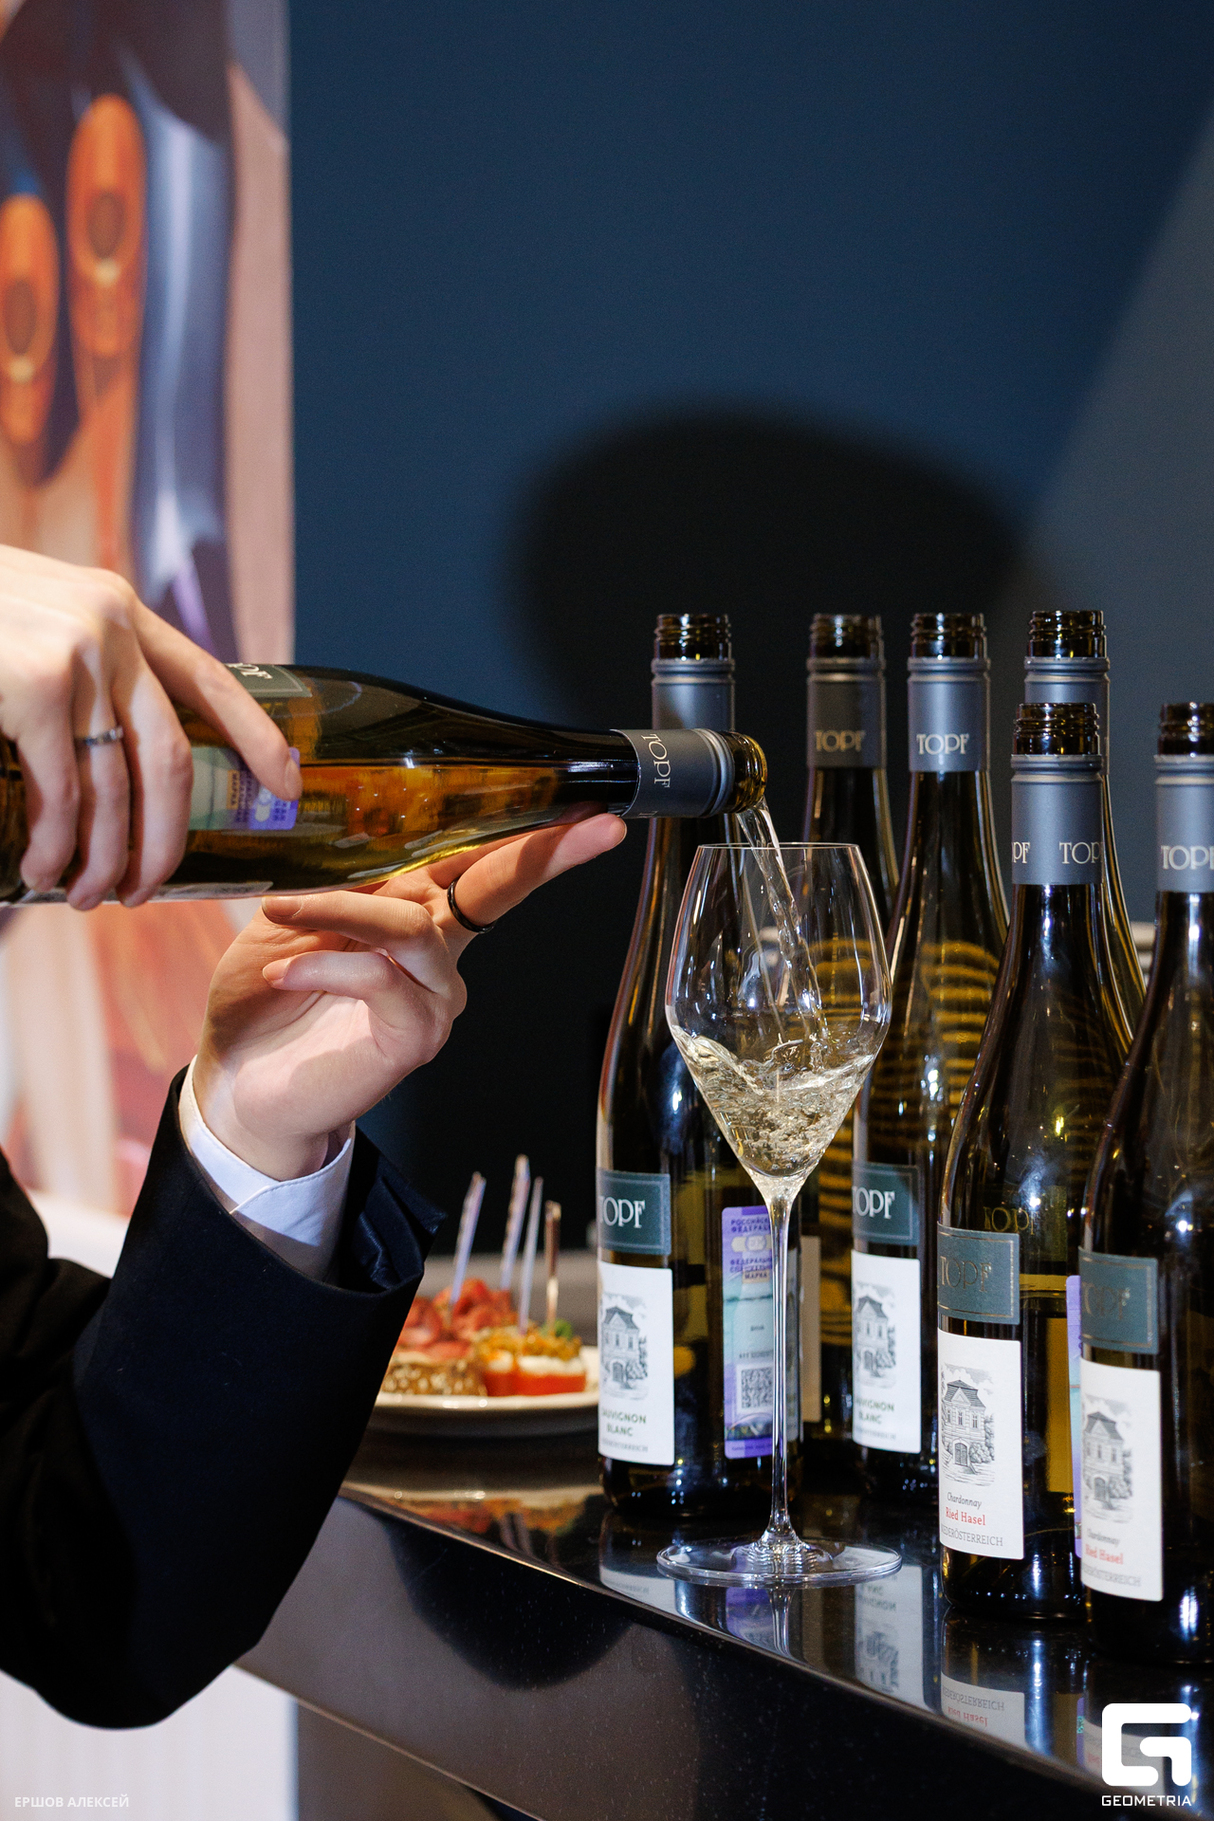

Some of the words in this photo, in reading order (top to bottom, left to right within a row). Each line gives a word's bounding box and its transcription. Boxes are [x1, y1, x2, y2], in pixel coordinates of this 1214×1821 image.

[815, 729, 866, 752] TOPF
[916, 733, 970, 755] TOPF
[641, 733, 671, 788] TOPF
[1011, 841, 1031, 864] PF
[940, 1255, 992, 1292] TOPF
[606, 1422, 634, 1437] BLANC
[946, 1490, 982, 1511] Chardonnay
[945, 1506, 959, 1521] Ried
[961, 1511, 986, 1526] Hasel
